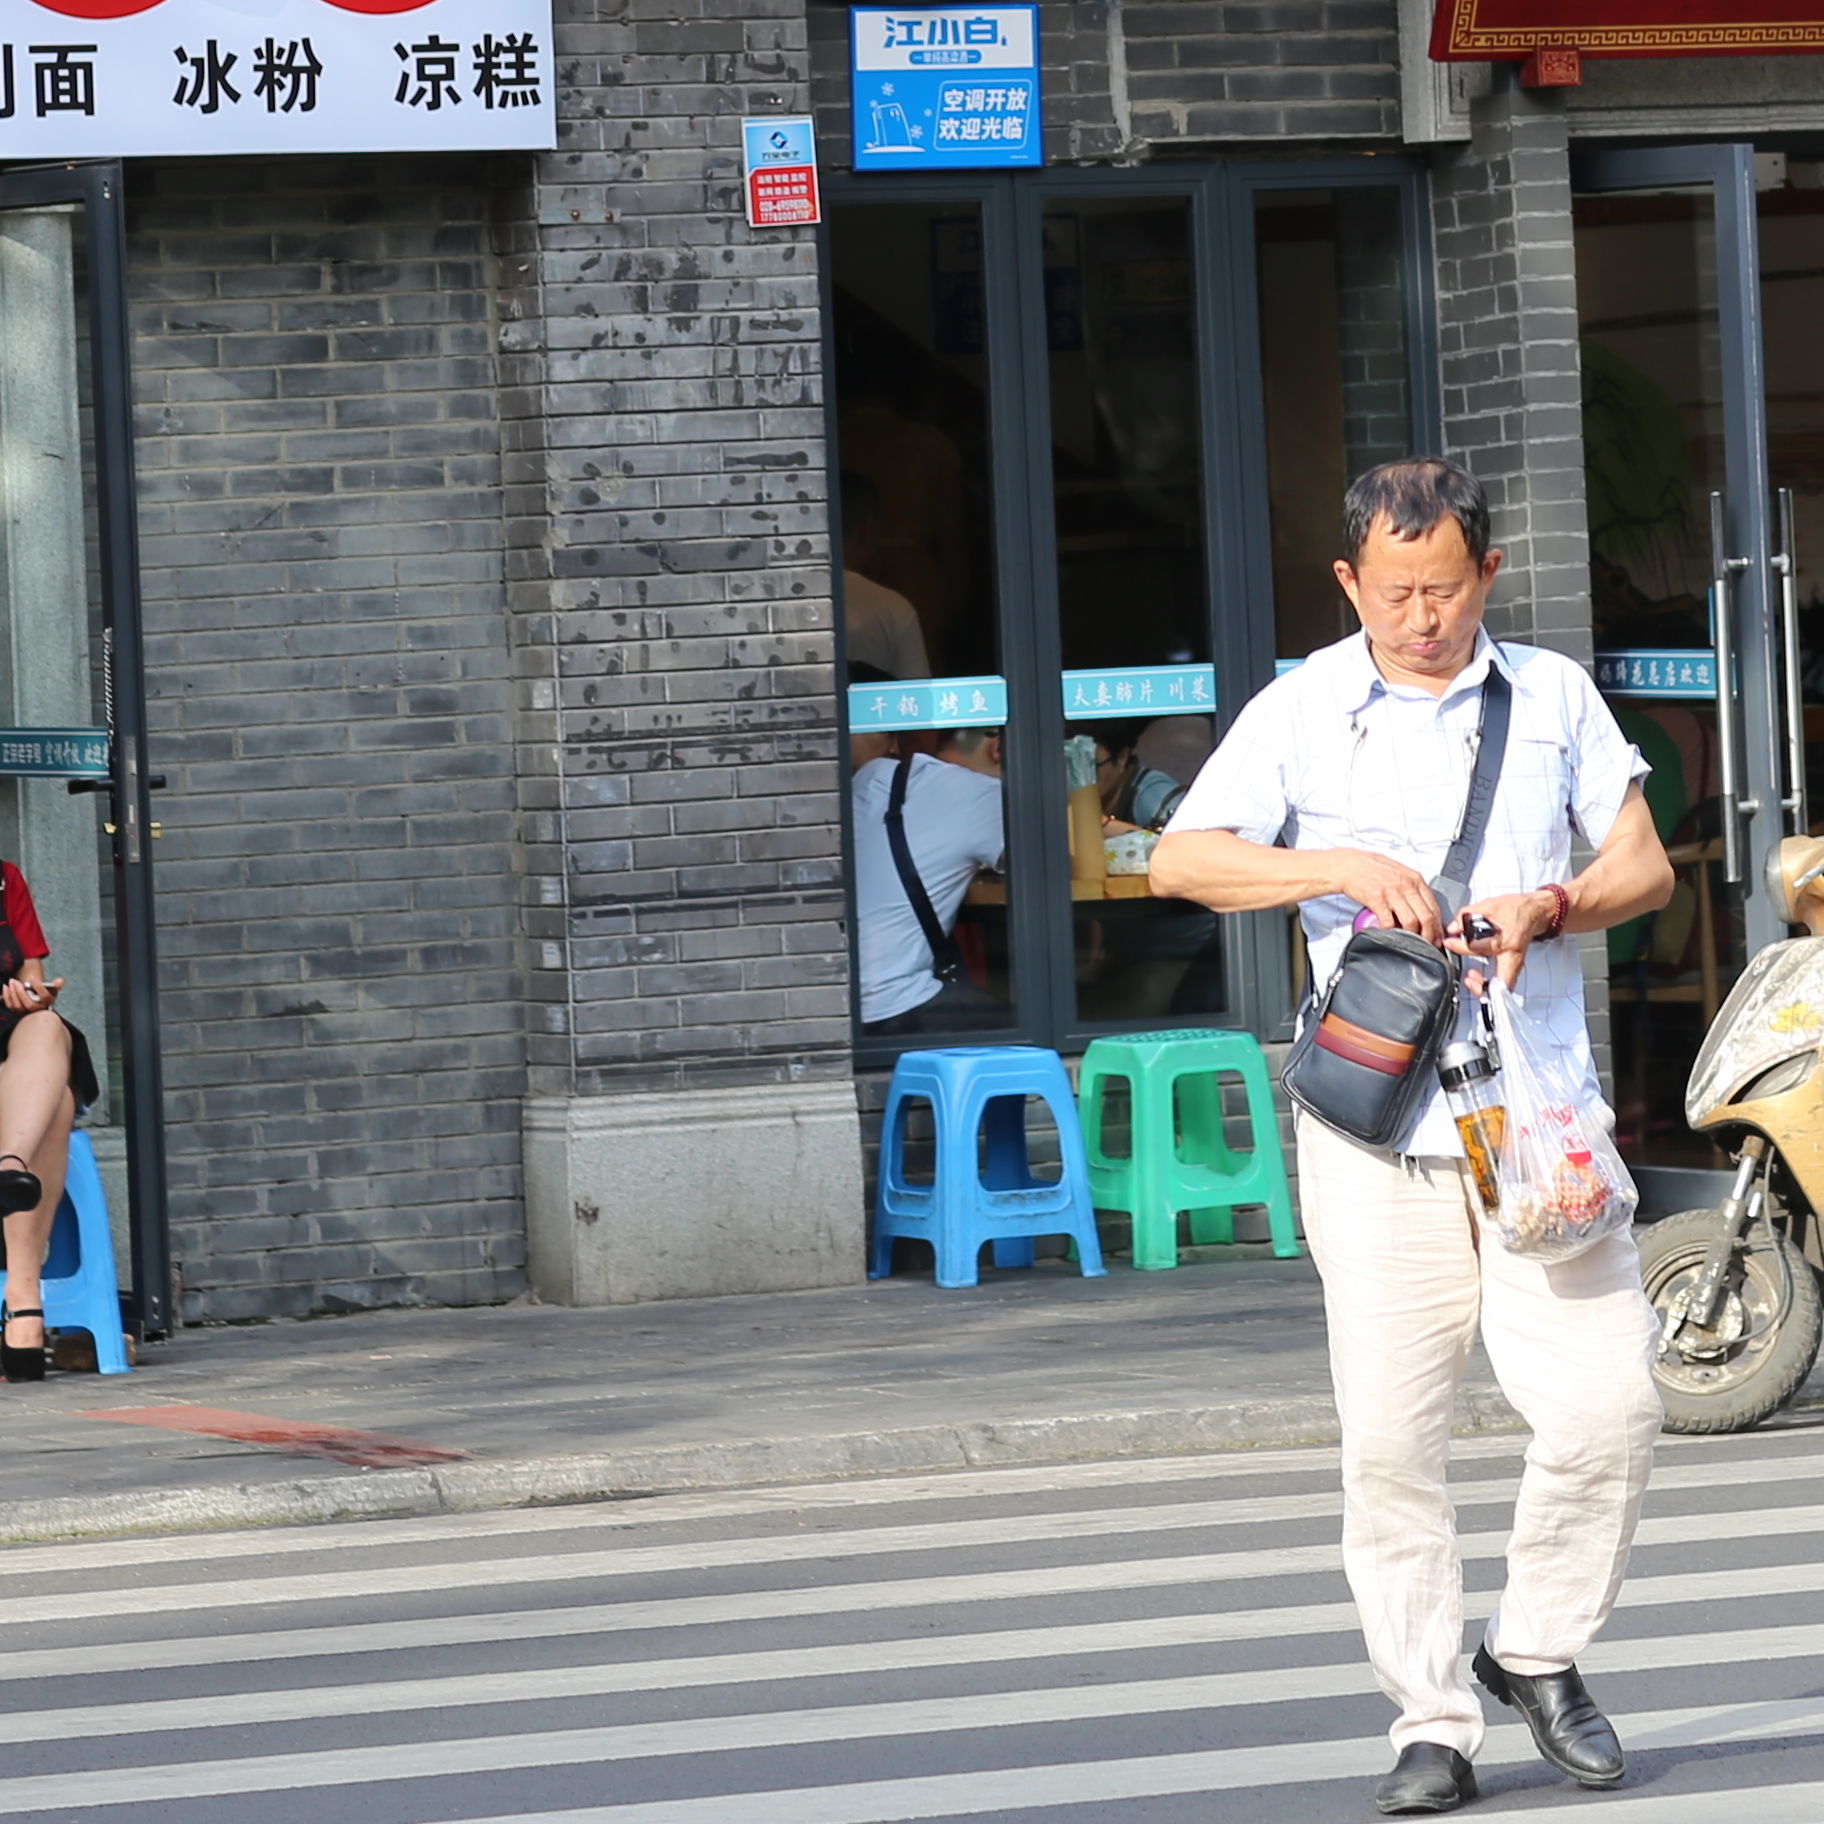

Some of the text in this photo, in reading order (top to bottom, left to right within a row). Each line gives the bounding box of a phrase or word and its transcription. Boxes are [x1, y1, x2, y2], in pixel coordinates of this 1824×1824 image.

[882, 16, 1000, 49] 江小白
[174, 36, 324, 114] 冰粉
[392, 32, 542, 111] 凉糕
[942, 87, 1028, 112] 空调开放
[938, 116, 1024, 141] 欢迎光临
[869, 689, 990, 719] 干锅 烤鱼
[1073, 675, 1212, 708] 夫妻肺片 川菜
